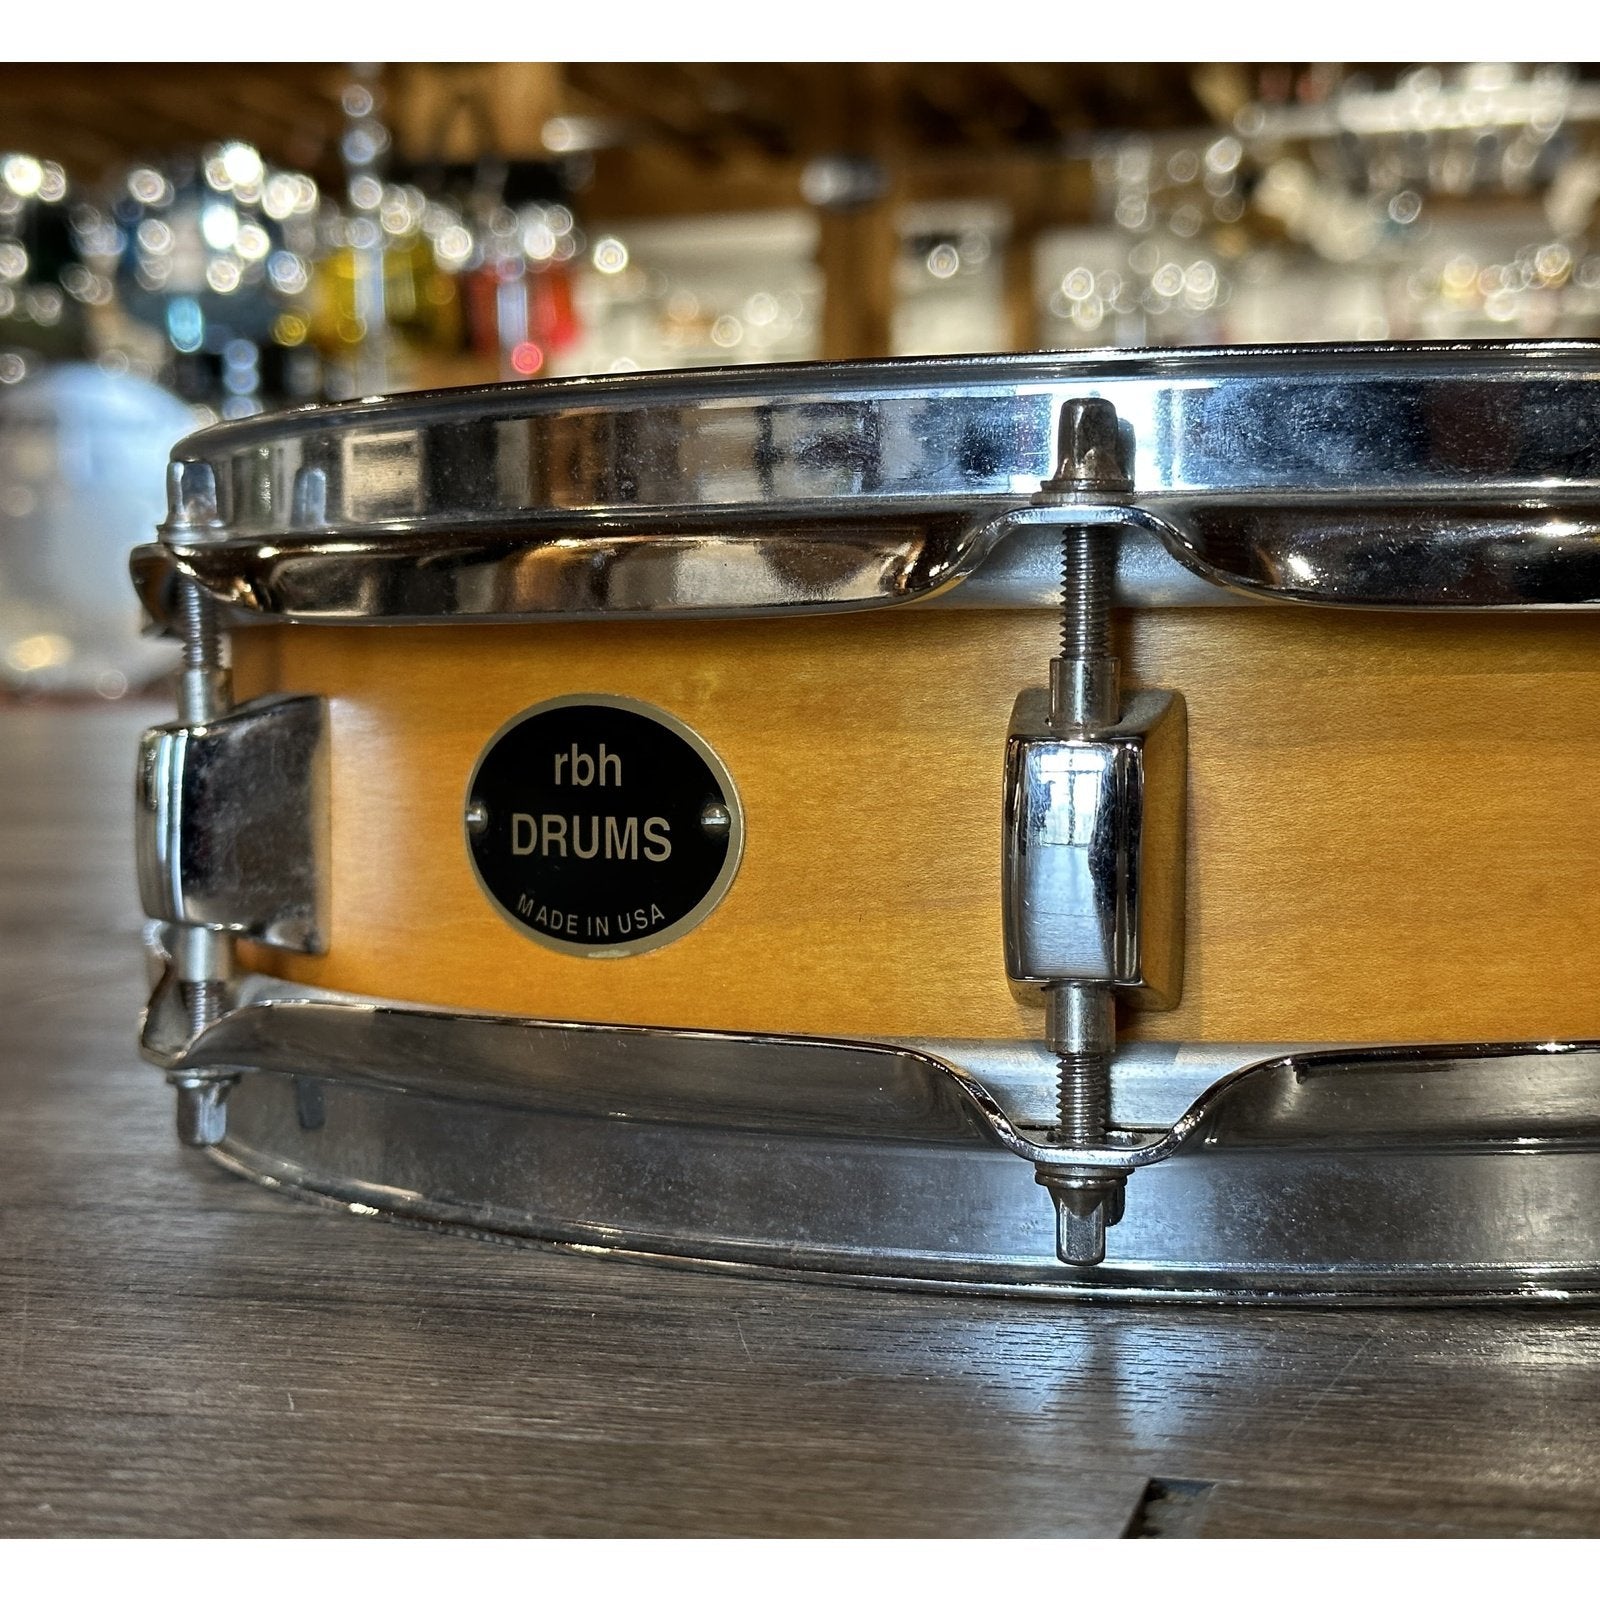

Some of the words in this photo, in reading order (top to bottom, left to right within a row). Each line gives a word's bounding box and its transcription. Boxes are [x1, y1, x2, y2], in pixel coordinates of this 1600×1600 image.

[554, 743, 622, 787] rbh
[511, 812, 673, 862] DRUMS
[517, 893, 579, 935] MADE
[586, 916, 610, 937] IN
[617, 903, 666, 934] USA
